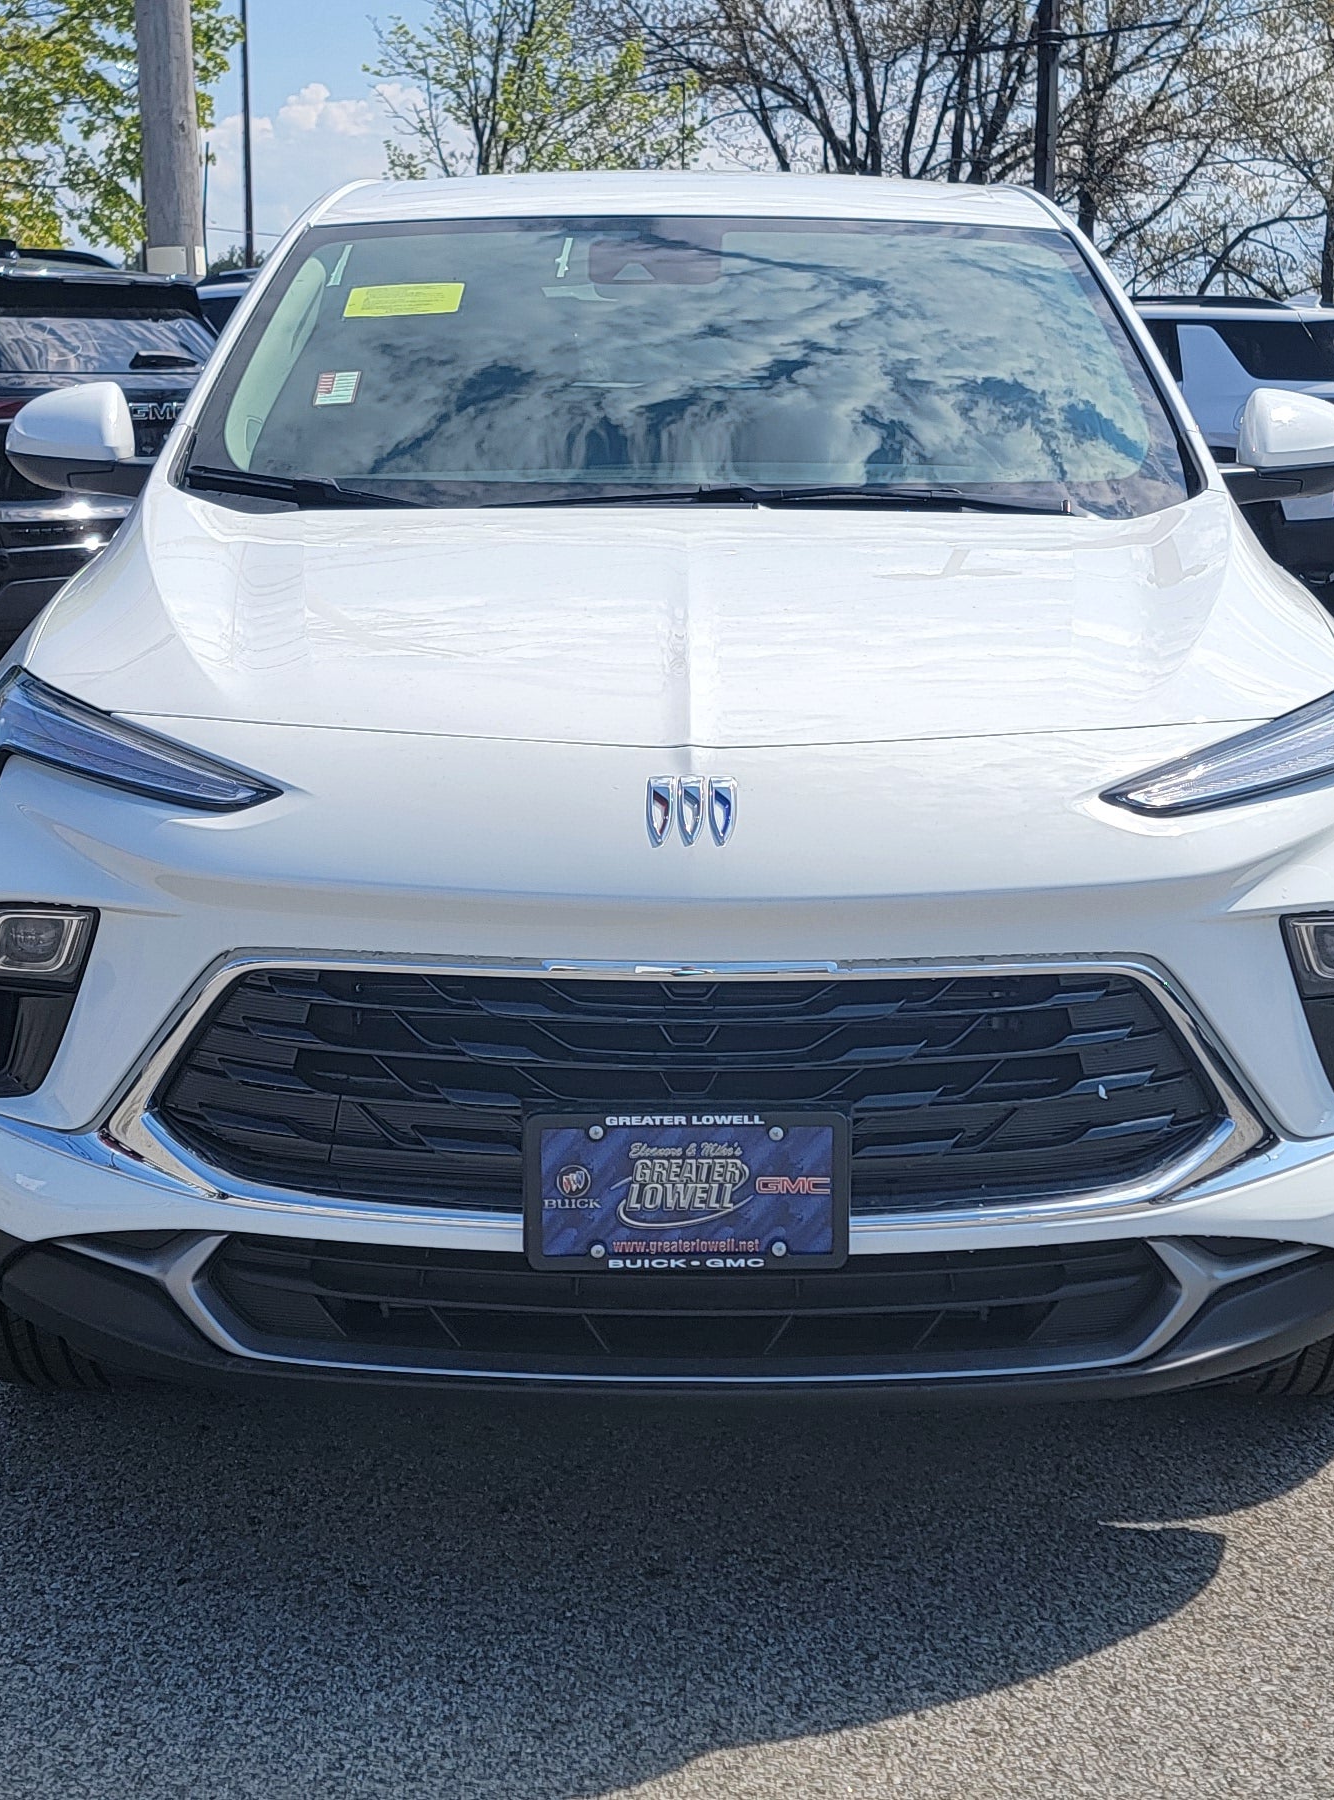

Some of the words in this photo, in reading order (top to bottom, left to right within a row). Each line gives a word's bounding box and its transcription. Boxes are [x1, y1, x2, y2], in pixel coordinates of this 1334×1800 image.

[605, 1115, 687, 1126] GREATER
[691, 1114, 766, 1125] LOWELL
[700, 1141, 743, 1157] Mike's
[632, 1159, 742, 1184] GREATER
[756, 1177, 831, 1195] GMC
[543, 1198, 602, 1209] BUICK
[627, 1183, 735, 1212] LOWELL
[612, 1238, 760, 1255] www.greaterlowell.net
[608, 1258, 687, 1269] BUICK
[705, 1258, 765, 1268] GMC
